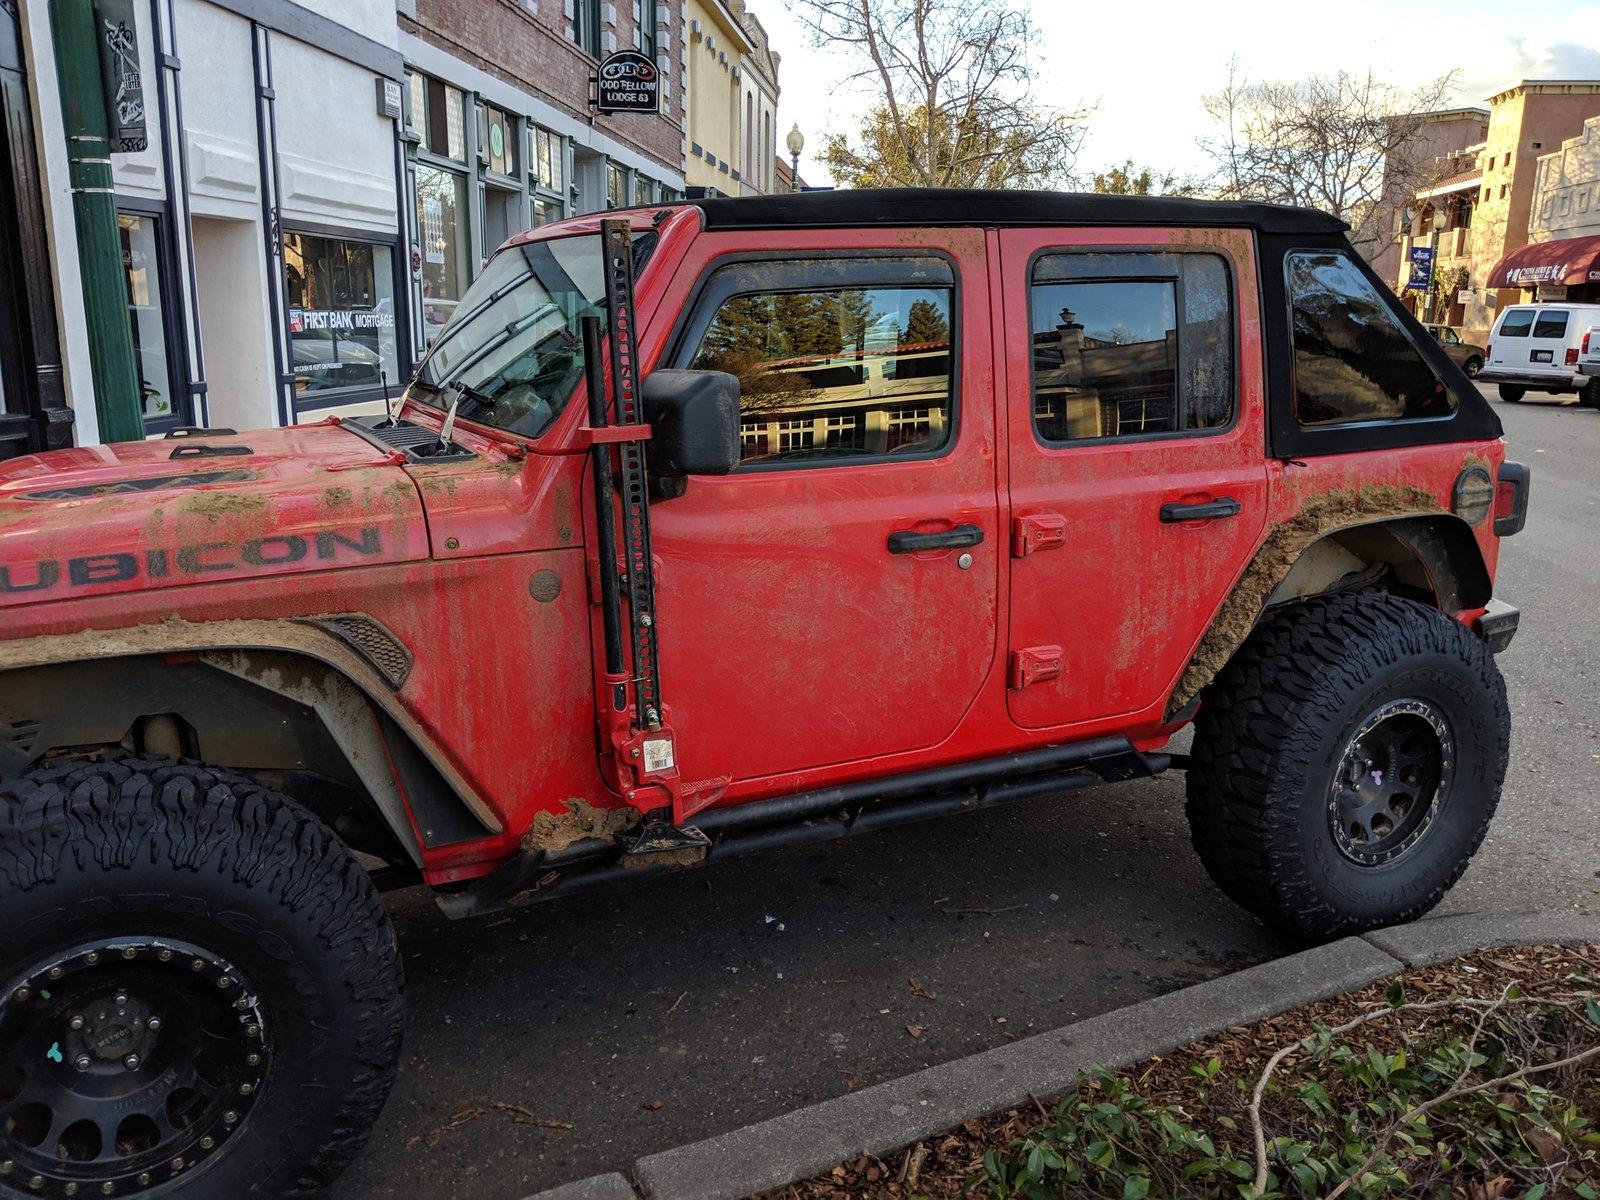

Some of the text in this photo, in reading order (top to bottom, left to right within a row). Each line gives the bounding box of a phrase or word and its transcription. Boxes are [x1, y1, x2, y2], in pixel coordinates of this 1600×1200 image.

[600, 80, 620, 90] ODD
[607, 92, 637, 102] LODGE
[304, 311, 394, 330] FIRST BANK MORTGAGE
